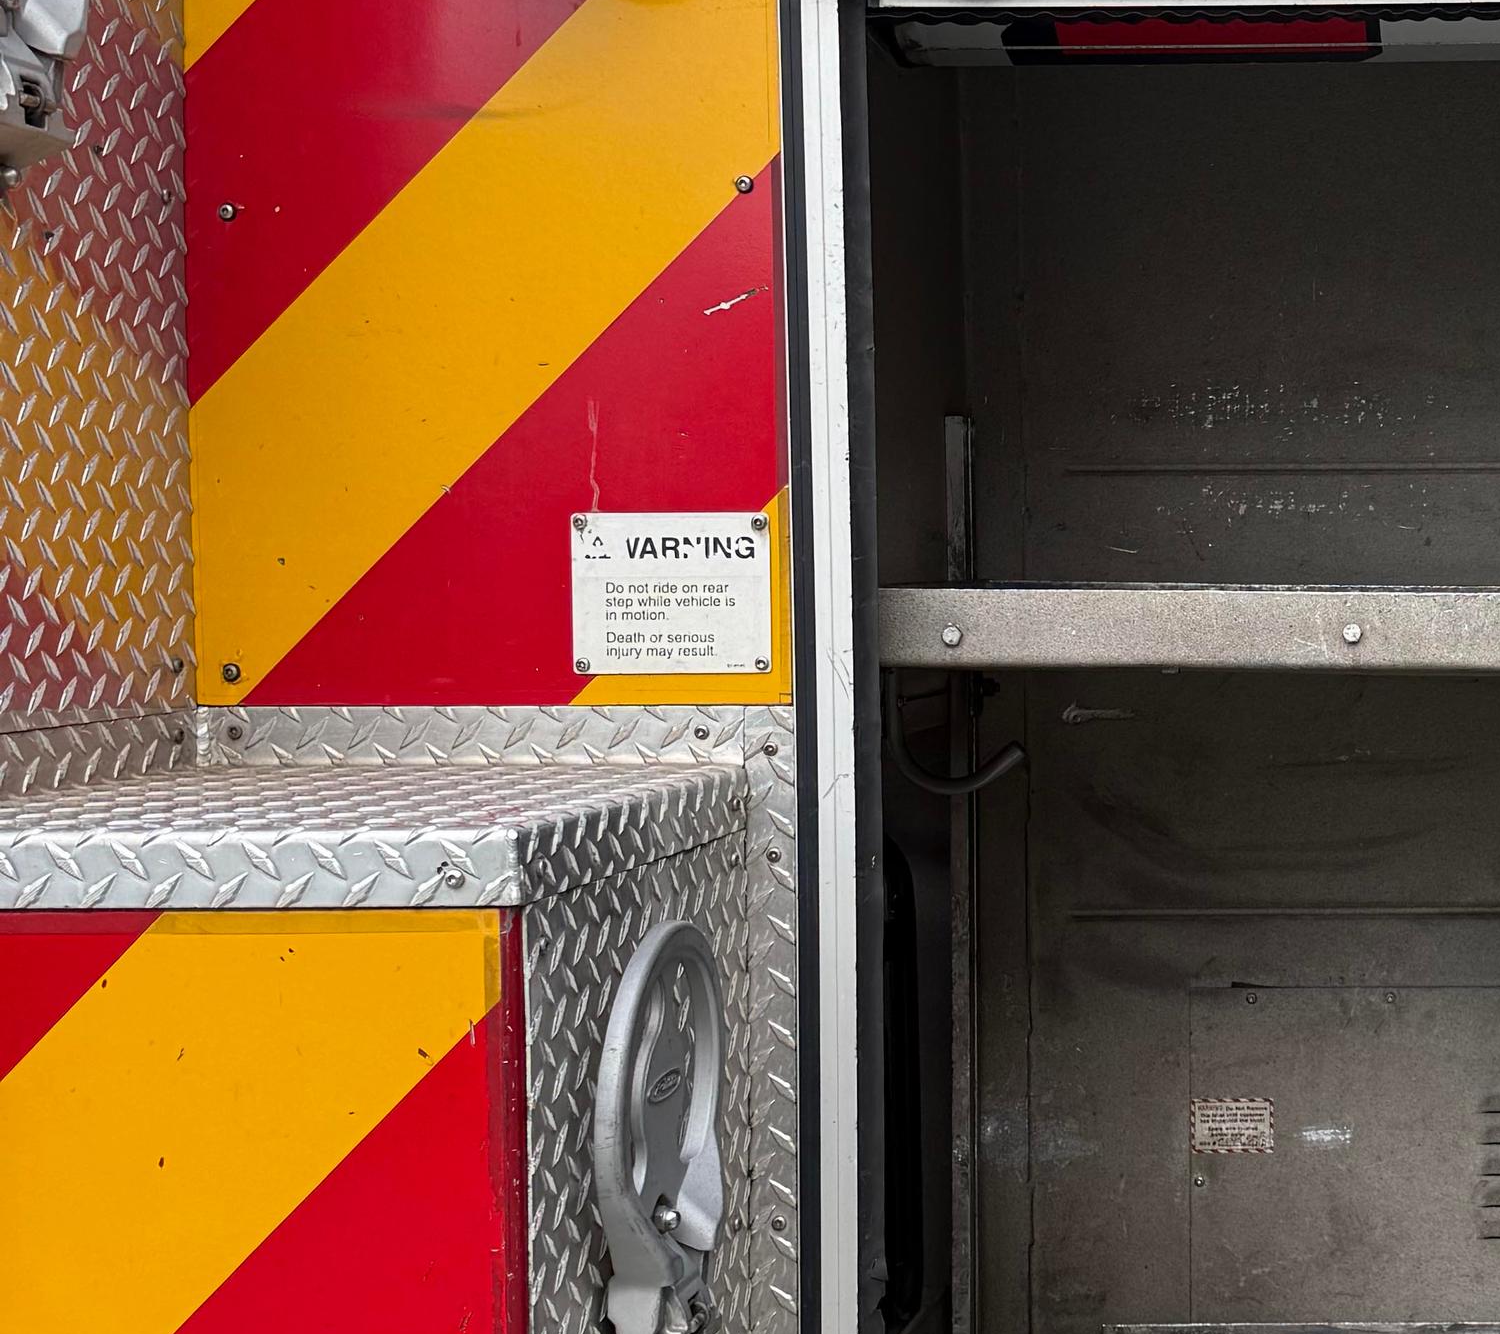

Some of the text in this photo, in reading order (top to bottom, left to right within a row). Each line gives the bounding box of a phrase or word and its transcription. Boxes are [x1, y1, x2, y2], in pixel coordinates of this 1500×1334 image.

[606, 582, 729, 593] Do not ride on rear
[605, 596, 736, 608] step while vehicle is
[606, 610, 670, 620] in motion.
[606, 631, 715, 643] Death or serious
[606, 646, 718, 659] injury may result.
